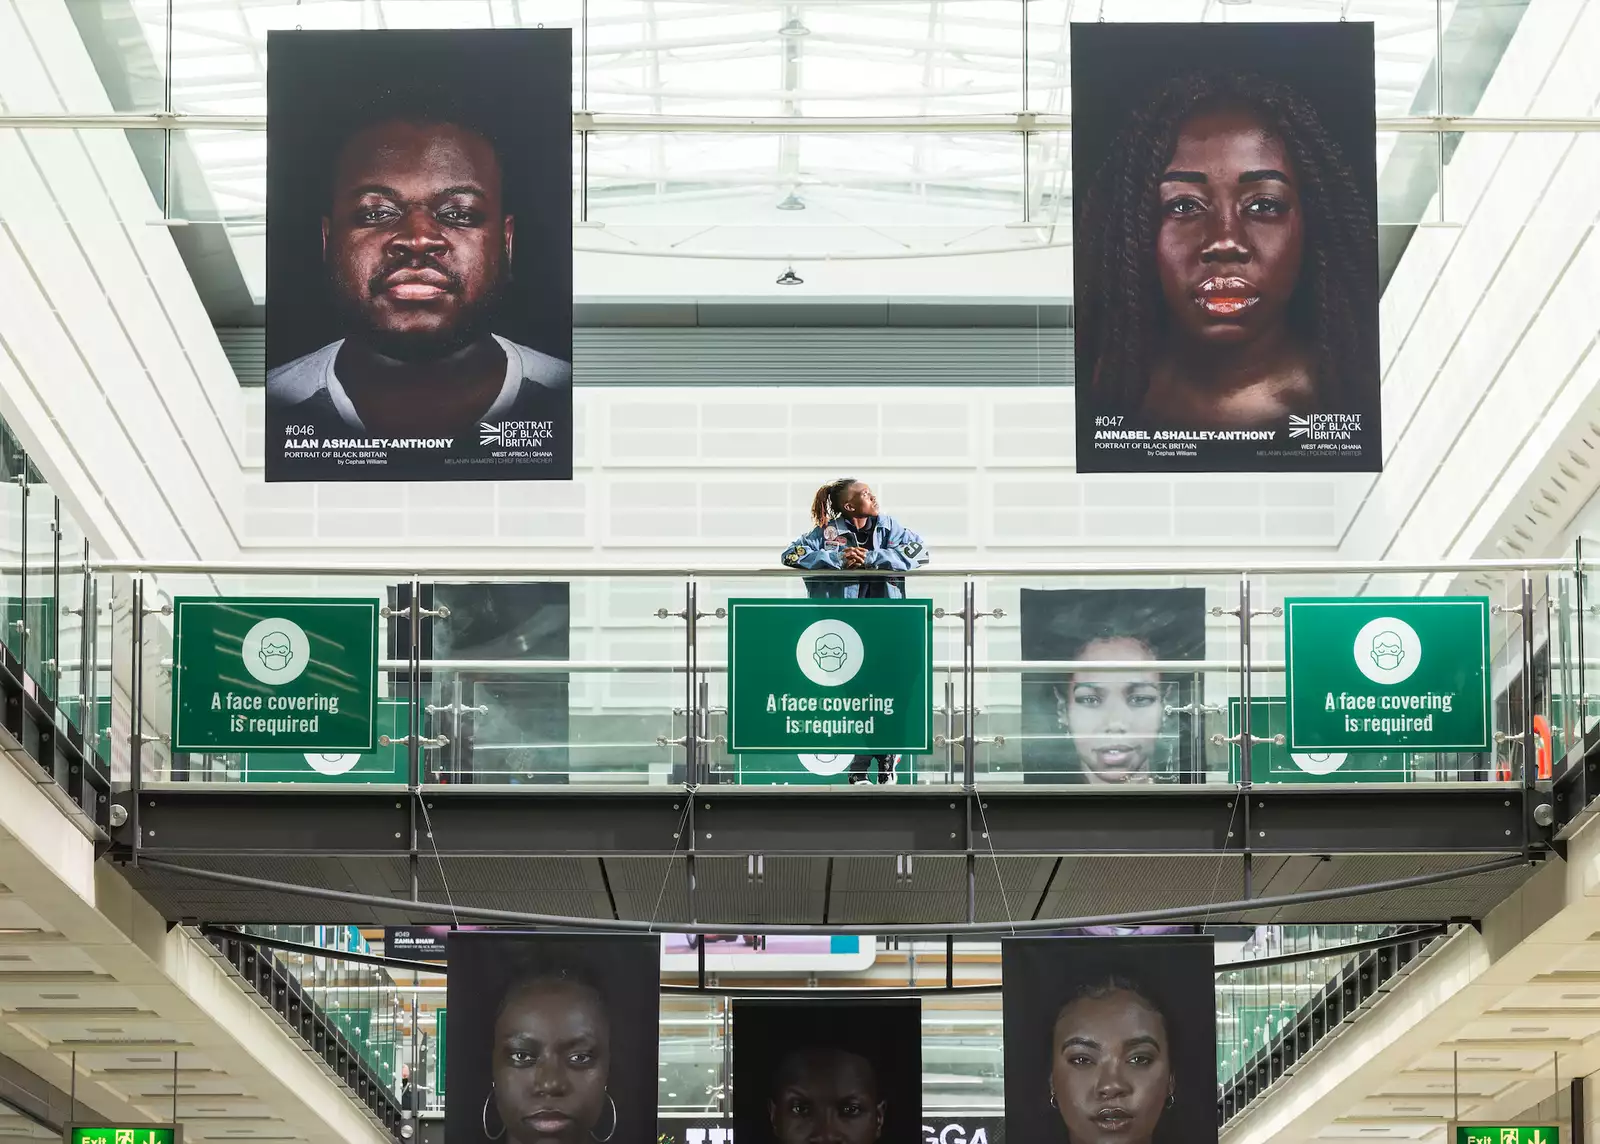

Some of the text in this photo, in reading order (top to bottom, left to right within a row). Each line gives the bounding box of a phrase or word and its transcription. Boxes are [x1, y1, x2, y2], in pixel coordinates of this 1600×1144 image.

[1095, 416, 1123, 426] #047
[1314, 414, 1361, 422] PORTRAIT
[505, 421, 553, 429] PORTRAIT
[1312, 422, 1362, 430] OF BLACK
[285, 425, 314, 435] #046
[504, 430, 553, 438] OF BLACK
[1095, 431, 1275, 440] ANNABEL ASHALLEY-ANTHONY
[1315, 431, 1351, 440] BRITAIN
[285, 439, 453, 448] ALAN ASHALLEY-ANTHONY
[506, 438, 542, 447] BRITAIN
[211, 692, 338, 714] A face covering
[766, 694, 894, 714] A face covering
[1325, 692, 1452, 712] A face covering
[230, 716, 318, 736] is required
[786, 716, 874, 737] is required
[1345, 714, 1432, 735] is required
[82, 1136, 106, 1144] Exit
[1468, 1136, 1492, 1144] Exit
